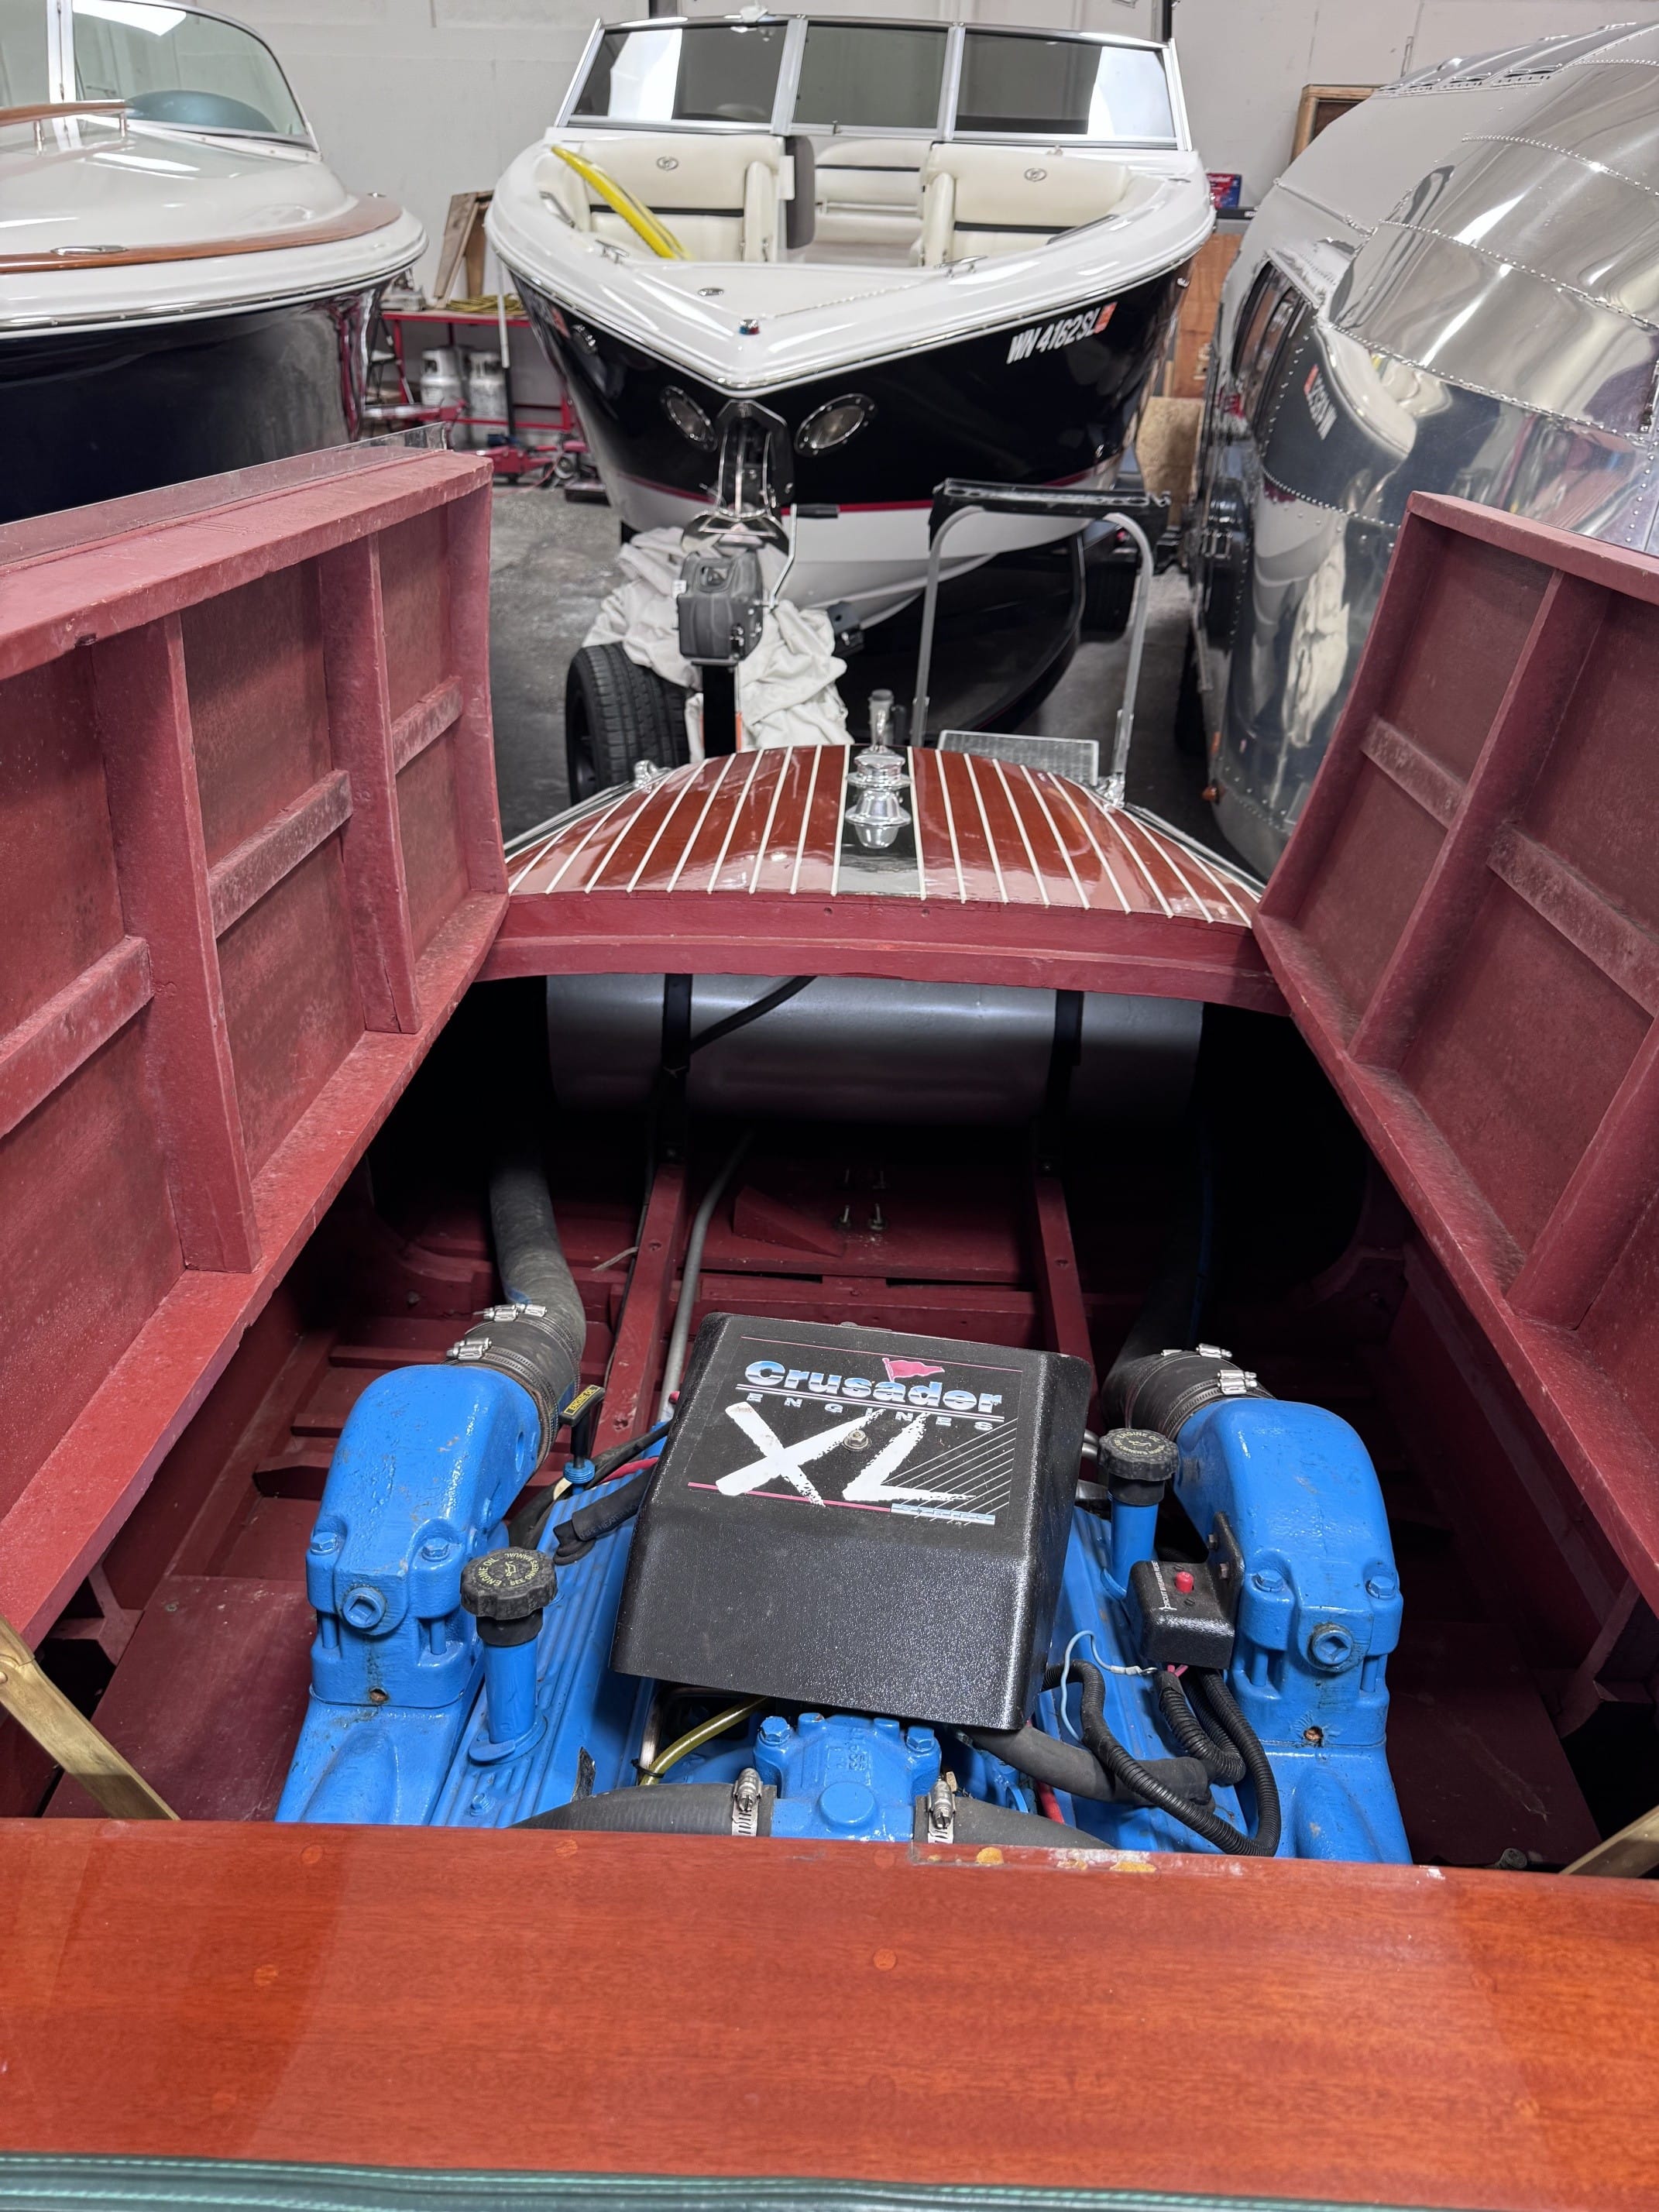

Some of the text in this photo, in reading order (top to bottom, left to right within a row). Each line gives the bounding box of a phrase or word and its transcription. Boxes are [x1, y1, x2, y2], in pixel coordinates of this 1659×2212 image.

[745, 1360, 1002, 1413] Crusader
[746, 1393, 994, 1432] ENGINES
[715, 1402, 977, 1507] XL
[478, 1558, 503, 1586] ENGINE OIL
[504, 1552, 534, 1561] MANUAL
[510, 1578, 527, 1586] SEE
